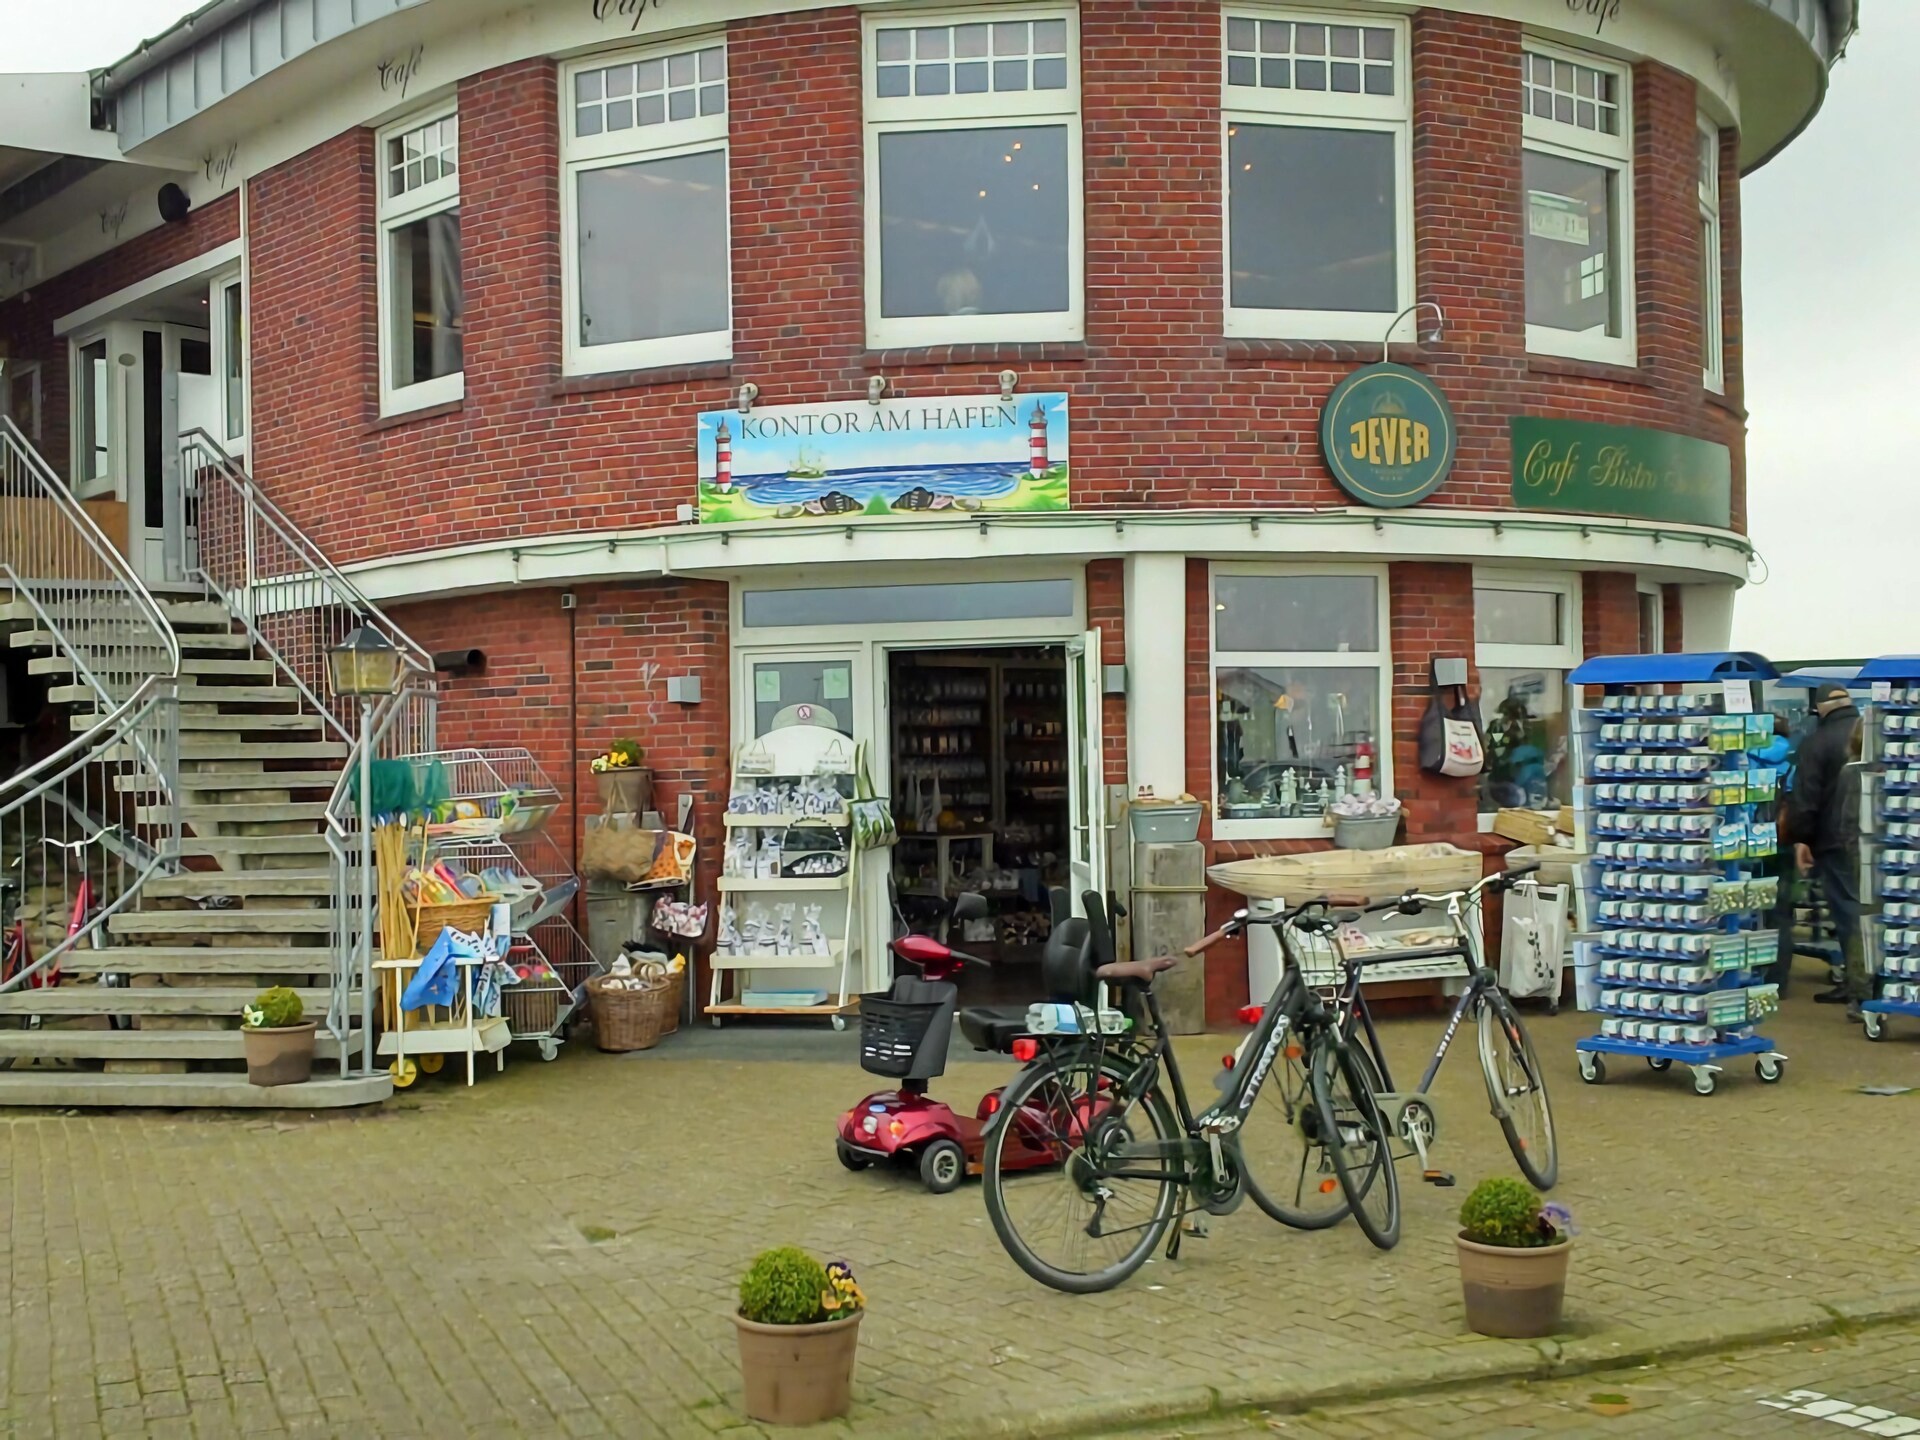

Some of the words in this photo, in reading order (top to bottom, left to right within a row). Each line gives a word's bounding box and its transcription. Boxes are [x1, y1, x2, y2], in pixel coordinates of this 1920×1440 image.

[740, 412, 861, 440] KONTOR
[868, 409, 912, 433] AM
[921, 405, 1018, 430] HAFEN
[1350, 417, 1431, 467] JEVER
[1523, 438, 1582, 497] Café
[1588, 444, 1659, 490] Bistro
[1239, 1014, 1291, 1109] STRATOS
